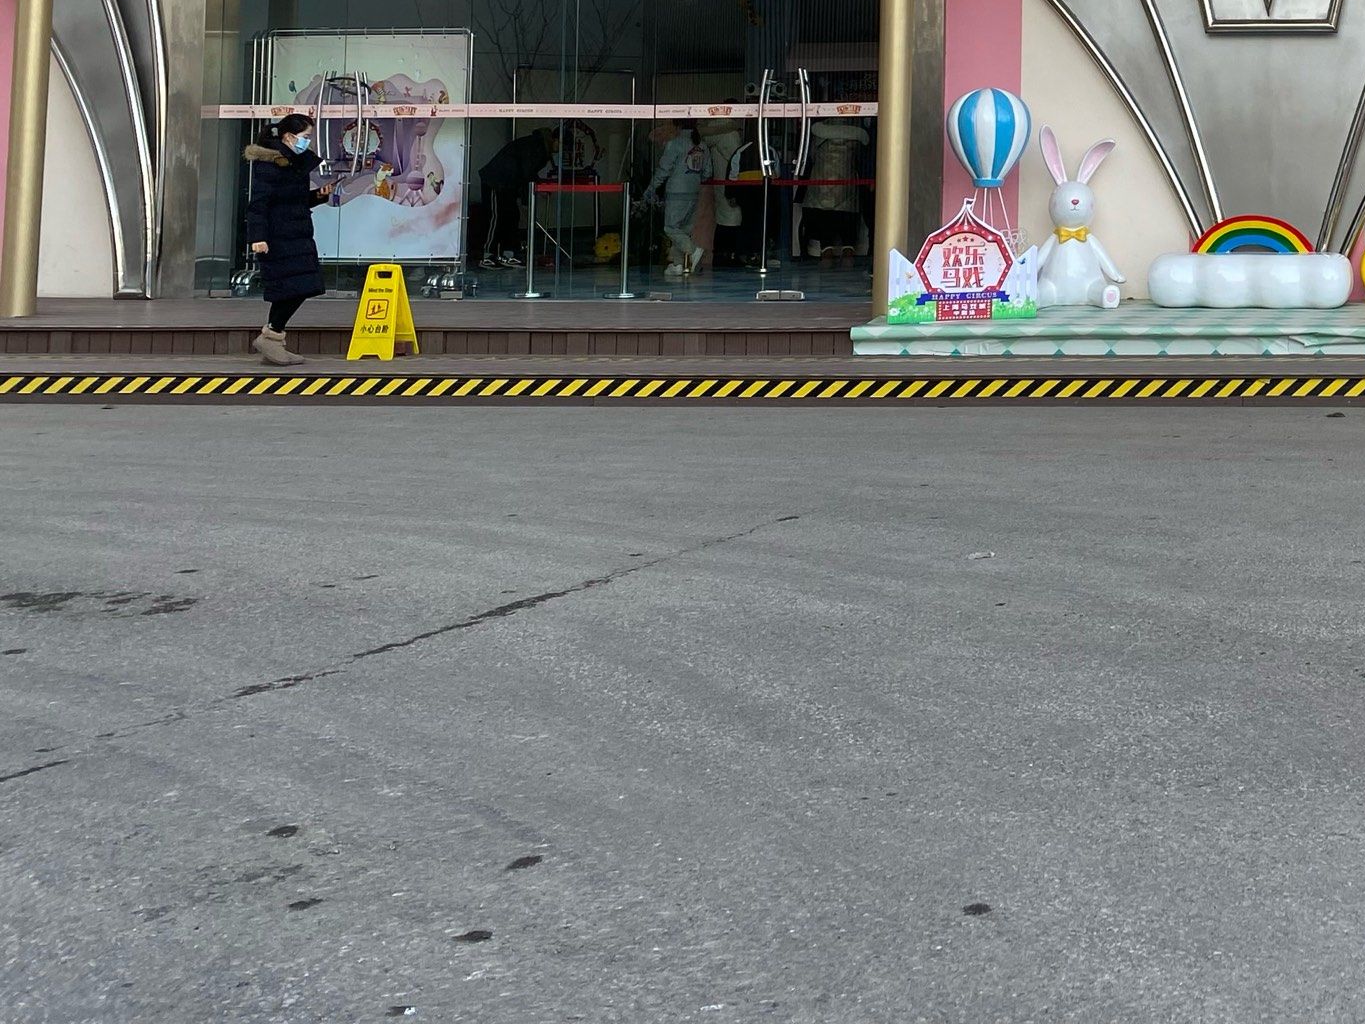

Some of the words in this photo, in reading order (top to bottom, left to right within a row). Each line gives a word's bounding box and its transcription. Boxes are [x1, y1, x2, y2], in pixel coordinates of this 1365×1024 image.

[942, 242, 985, 267] 欢乐
[940, 267, 985, 288] 马戏
[931, 293, 961, 301] HAPPY
[360, 324, 389, 333] 小心台阶
